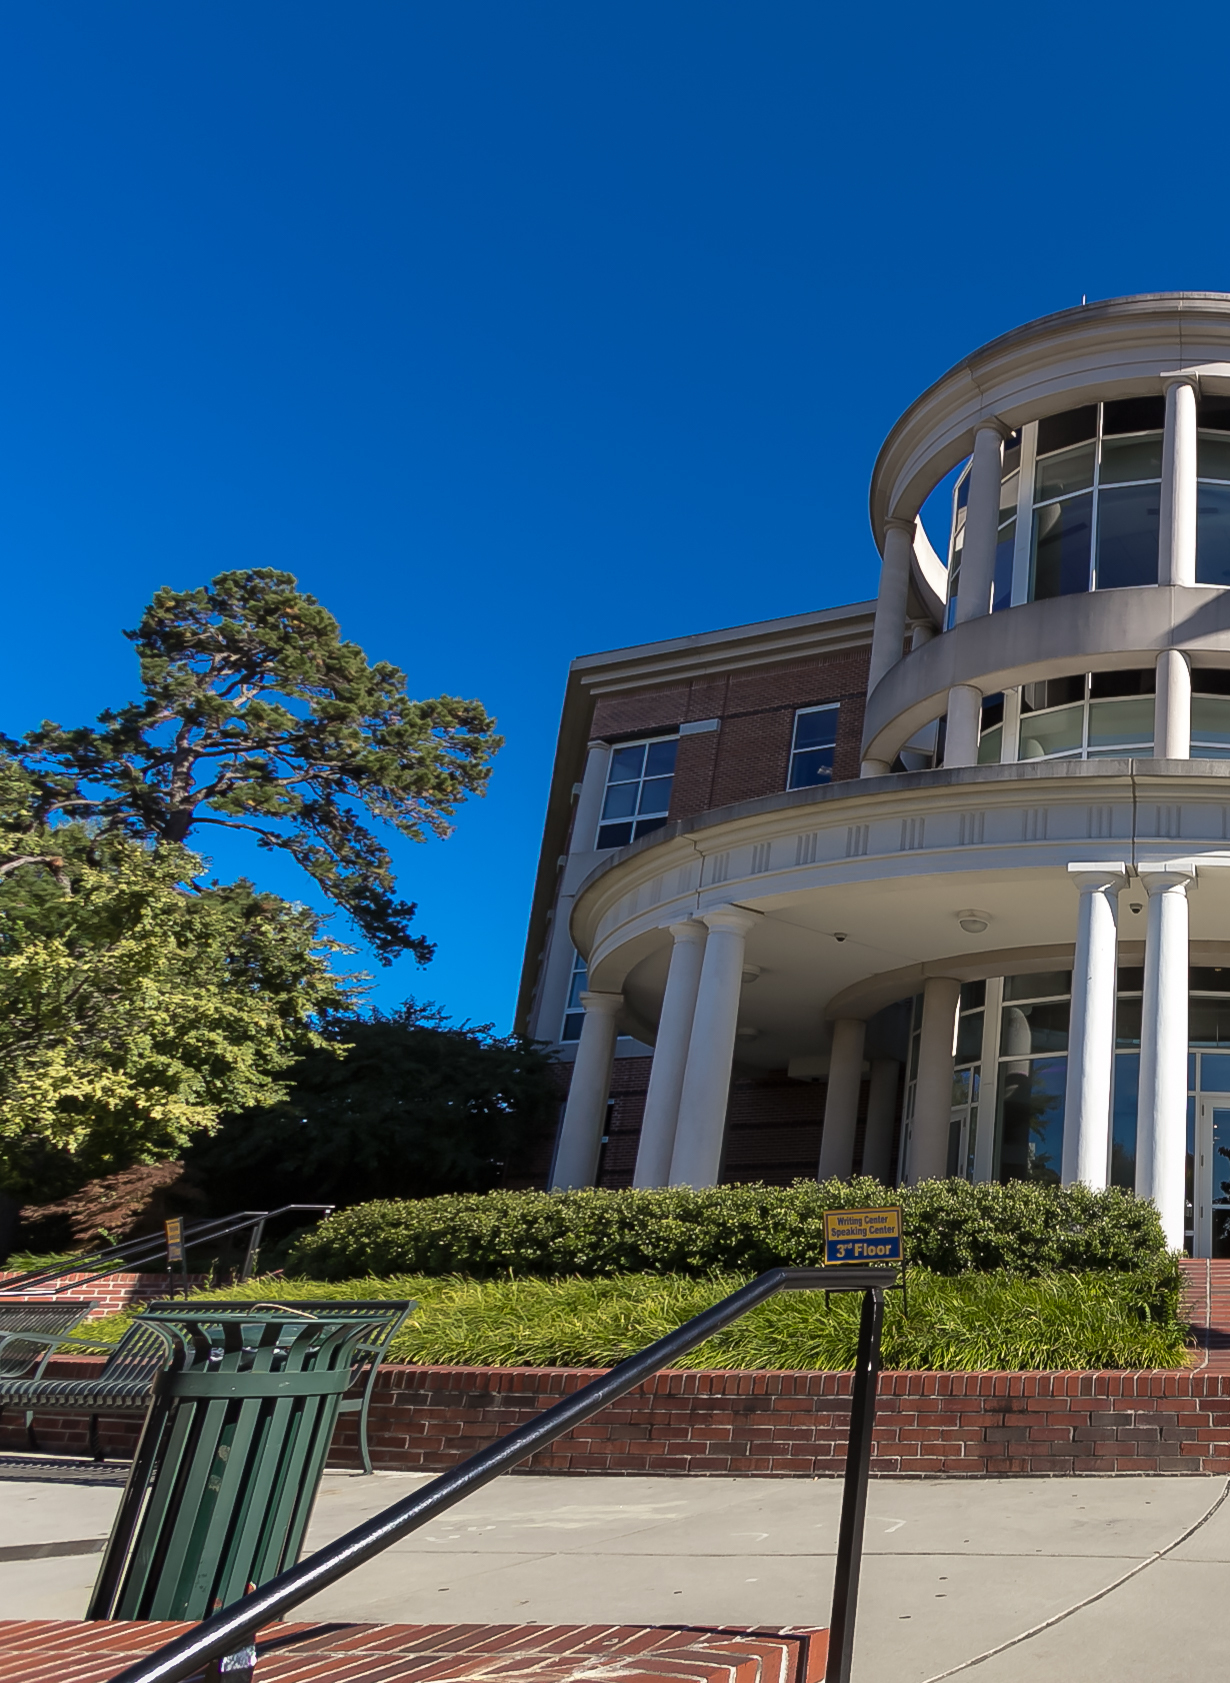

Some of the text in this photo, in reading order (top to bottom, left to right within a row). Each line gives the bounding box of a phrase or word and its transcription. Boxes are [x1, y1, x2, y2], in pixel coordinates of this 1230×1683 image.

[837, 1215, 888, 1227] Writing Center
[831, 1226, 895, 1238] Speaking Center
[836, 1243, 892, 1258] 3rd Floor
